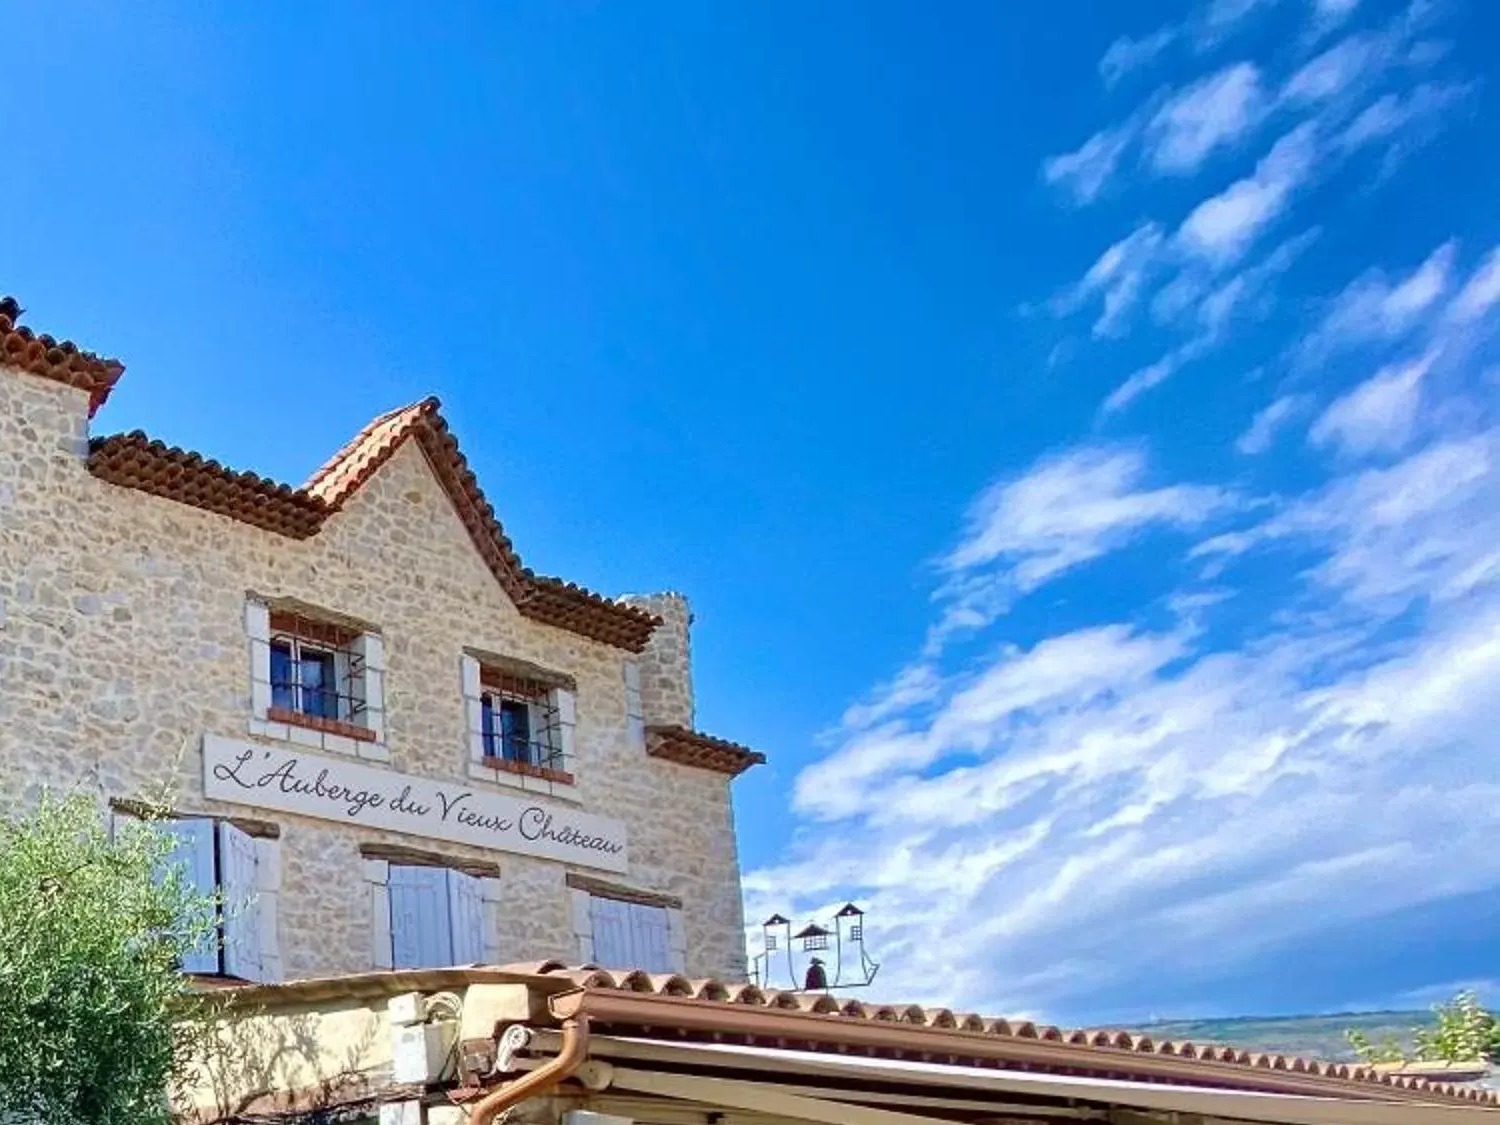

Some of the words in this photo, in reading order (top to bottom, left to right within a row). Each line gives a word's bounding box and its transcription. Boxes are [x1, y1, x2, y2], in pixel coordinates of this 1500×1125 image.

[213, 750, 385, 817] L'Auberge
[389, 785, 431, 815] du
[435, 791, 513, 832] Vieux
[518, 807, 624, 854] Château
